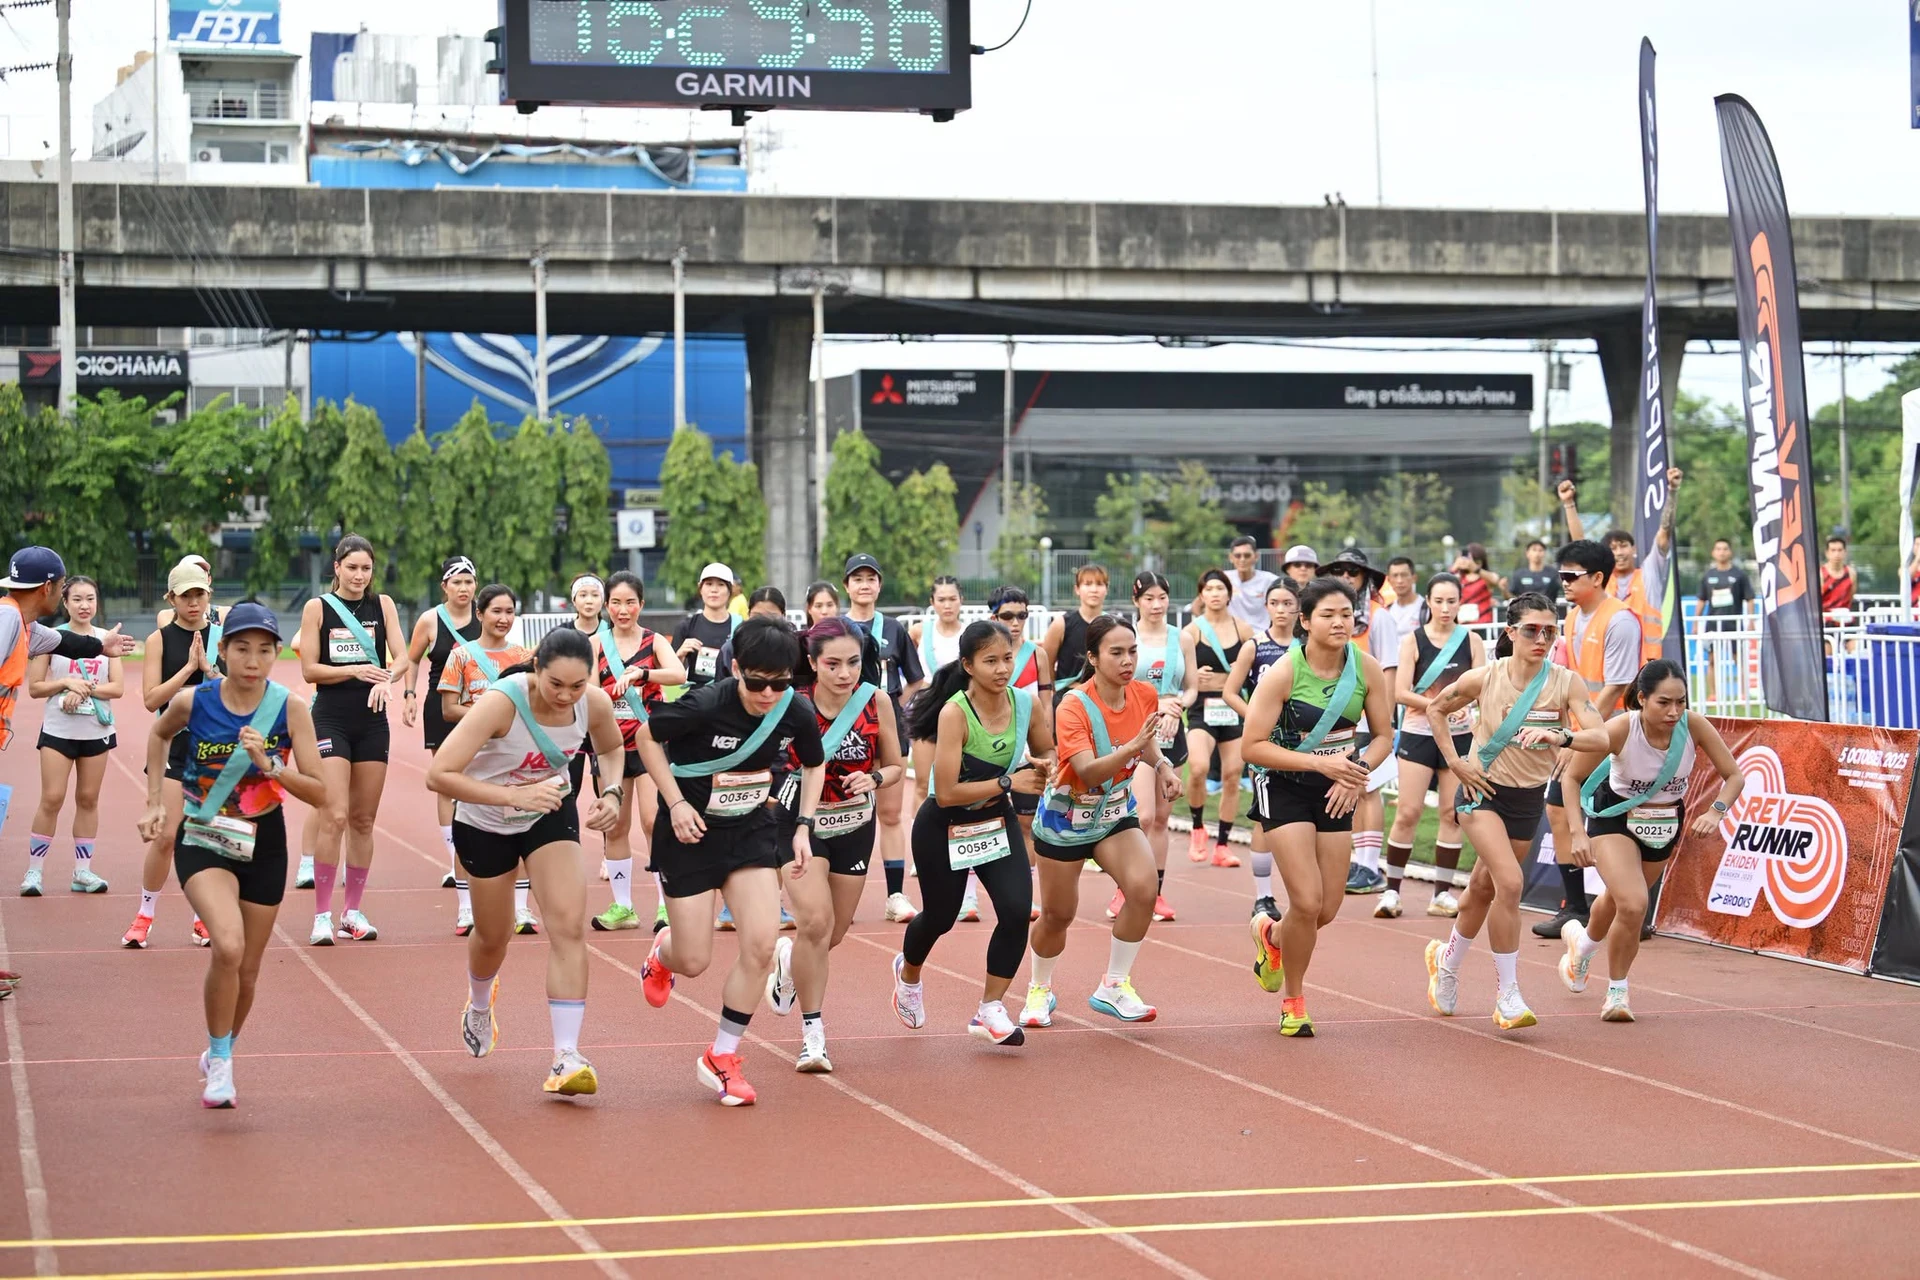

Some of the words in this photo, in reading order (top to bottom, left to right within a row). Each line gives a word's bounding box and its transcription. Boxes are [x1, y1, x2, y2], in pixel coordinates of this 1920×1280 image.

[176, 10, 274, 43] FBT
[675, 72, 811, 98] GARMIN
[76, 355, 182, 377] OKOHAMA
[906, 380, 976, 393] MITSUBISHI
[906, 392, 959, 405] MOTORS
[711, 735, 742, 750] KGT
[1838, 747, 1849, 763] 5
[1883, 752, 1910, 769] 2025
[1742, 796, 1797, 825] REV
[1731, 824, 1813, 859] RUNNR
[1724, 854, 1759, 870] EKIDEN
[1723, 894, 1752, 909] BROOKS
